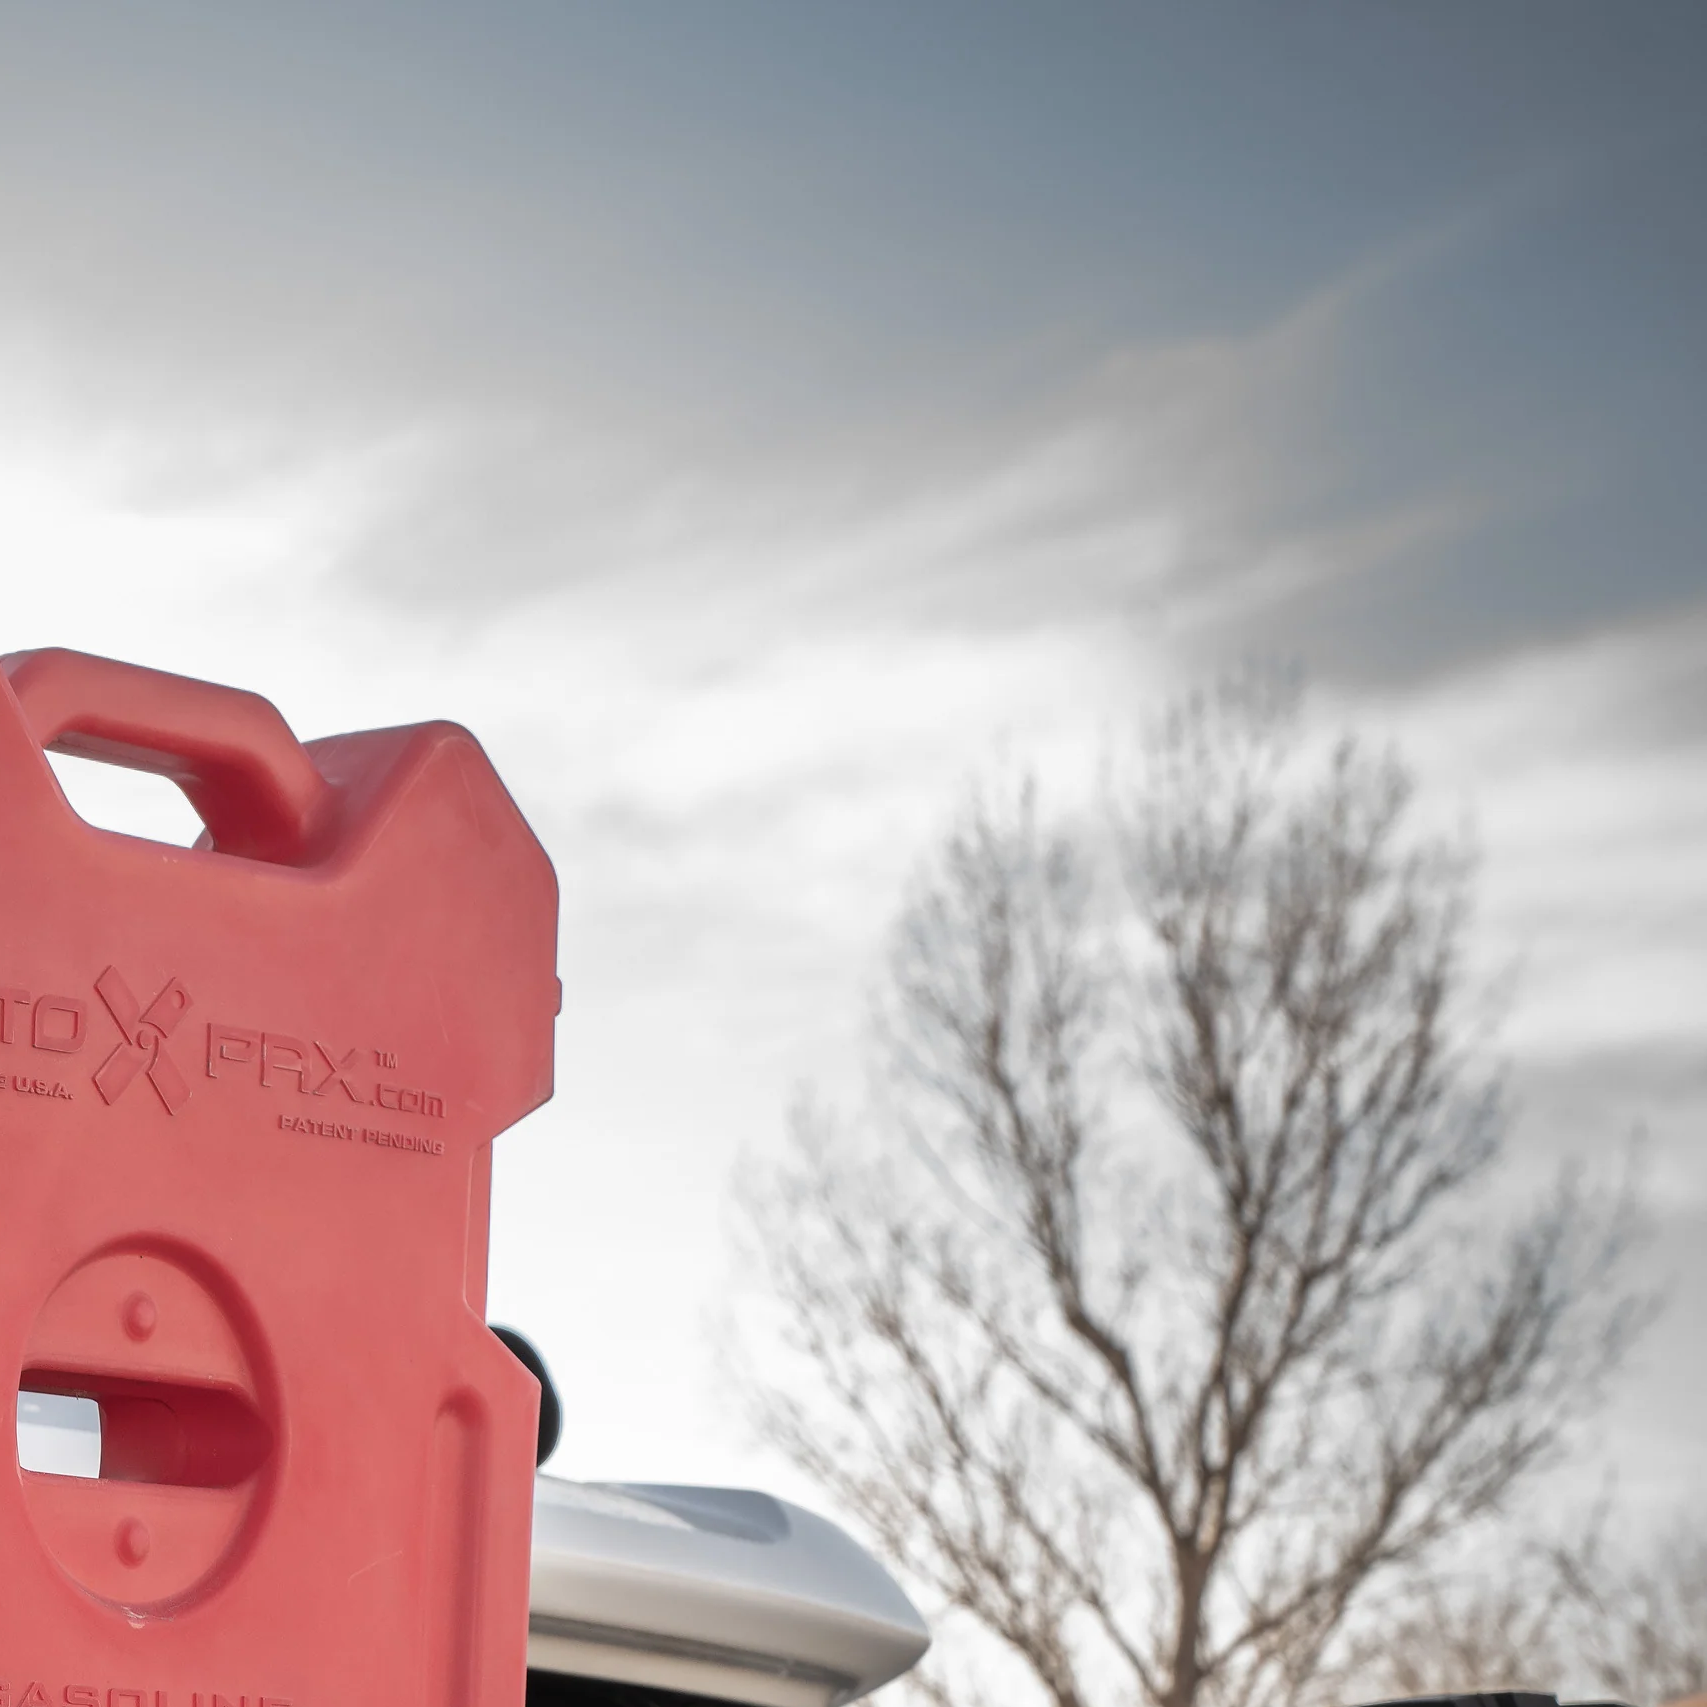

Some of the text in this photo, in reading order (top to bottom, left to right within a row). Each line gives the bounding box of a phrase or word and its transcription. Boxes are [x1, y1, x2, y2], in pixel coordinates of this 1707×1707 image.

[14, 1074, 74, 1100] U.S.A.
[278, 1113, 446, 1157] PATENT PENDING
